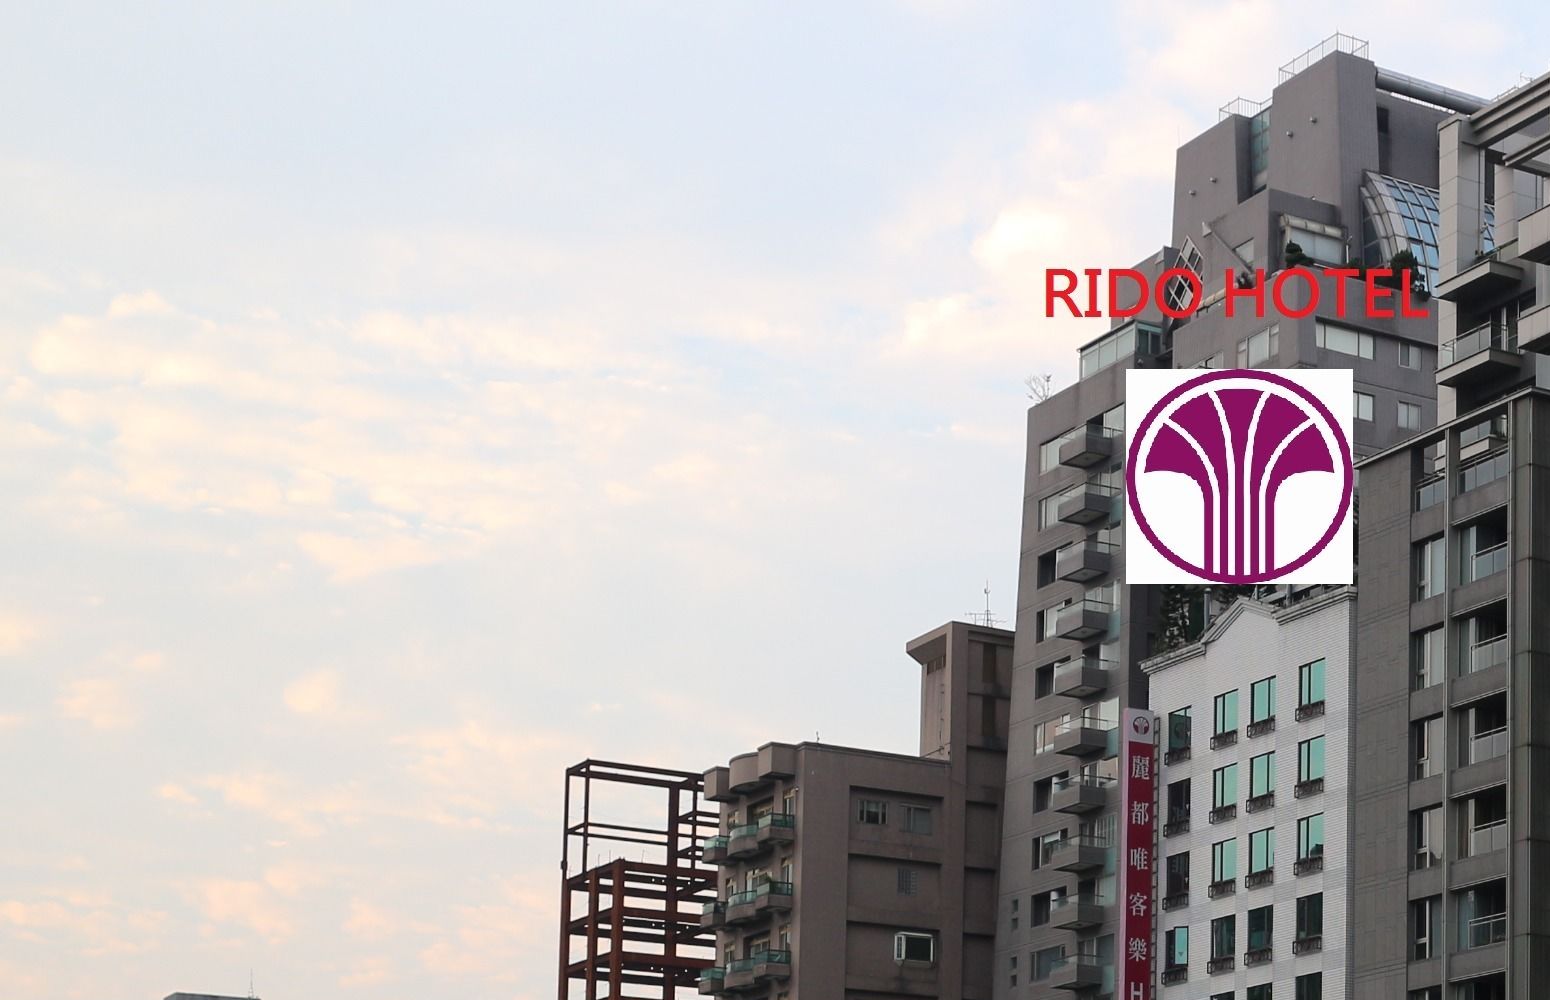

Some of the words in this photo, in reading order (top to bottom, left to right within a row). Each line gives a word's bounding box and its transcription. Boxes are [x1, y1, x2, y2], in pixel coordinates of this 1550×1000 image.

[1129, 755, 1150, 962] 麗都唯客樂
